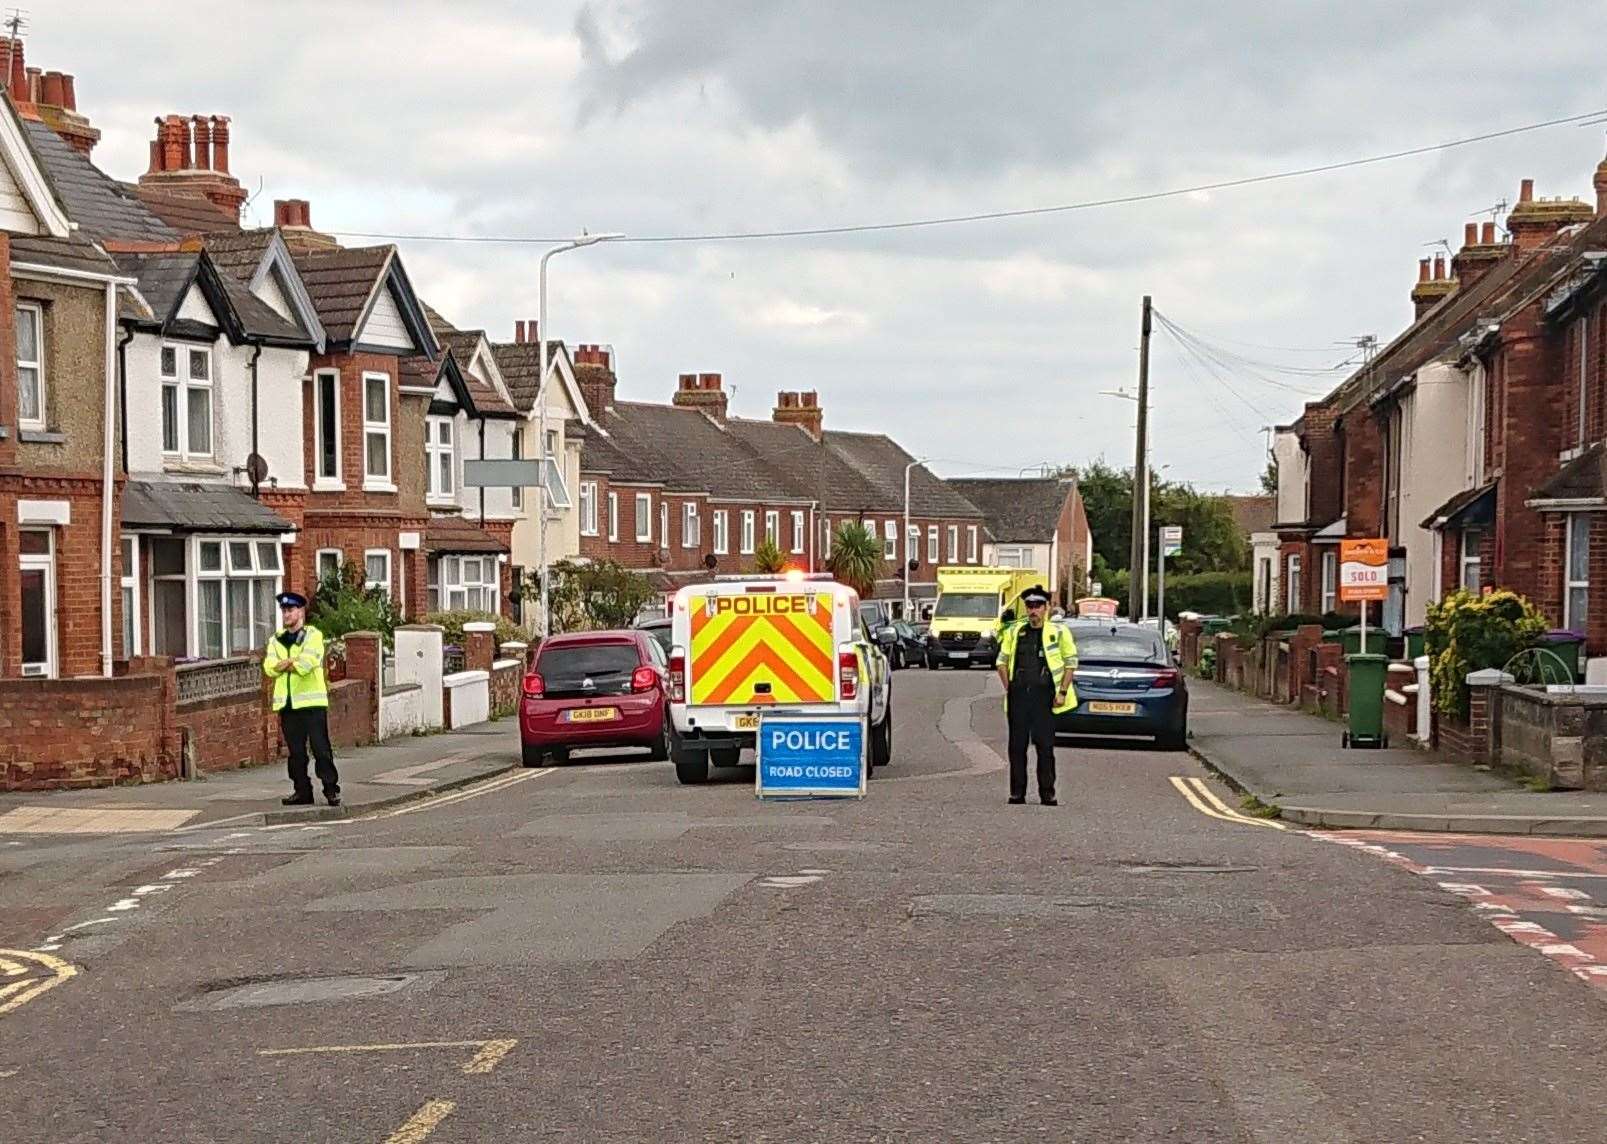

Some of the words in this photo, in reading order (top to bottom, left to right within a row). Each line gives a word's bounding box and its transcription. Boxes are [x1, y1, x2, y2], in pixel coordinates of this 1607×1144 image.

[1351, 571, 1377, 582] SOLD
[717, 595, 806, 615] POLICE
[772, 730, 850, 750] POLICE
[769, 766, 803, 777] ROAD
[805, 766, 853, 778] CLOSED
